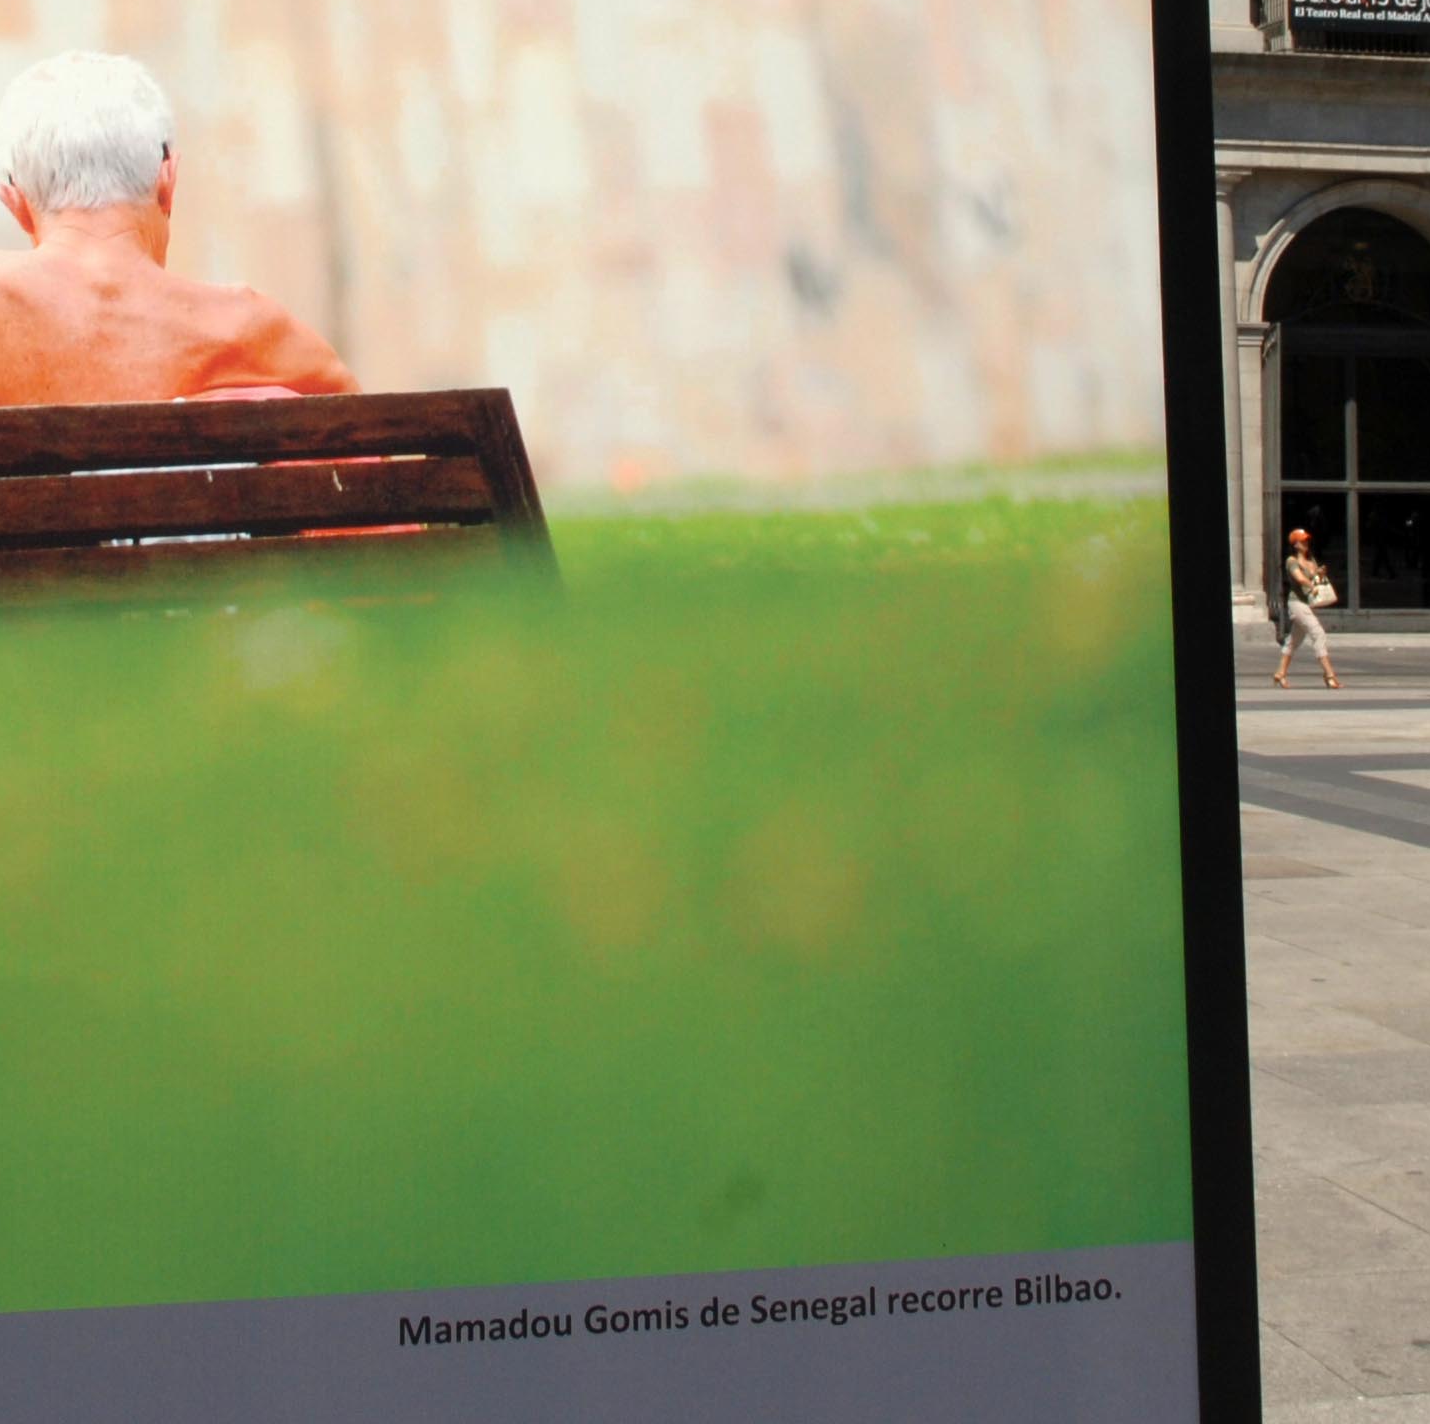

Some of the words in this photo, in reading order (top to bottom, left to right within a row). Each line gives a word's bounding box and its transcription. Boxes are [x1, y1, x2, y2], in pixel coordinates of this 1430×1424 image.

[1294, 6, 1305, 17] El
[1306, 7, 1339, 19] Teatro
[1339, 8, 1361, 20] Real
[1362, 12, 1374, 21] en
[1376, 11, 1385, 21] el
[1387, 11, 1421, 23] Madrid
[399, 1308, 571, 1347] Mamadou
[584, 1300, 689, 1335] Gomis
[700, 1296, 740, 1328] de
[750, 1286, 876, 1326] Senegal
[888, 1286, 1003, 1315] recorre
[1015, 1273, 1122, 1307] Bilbao.
